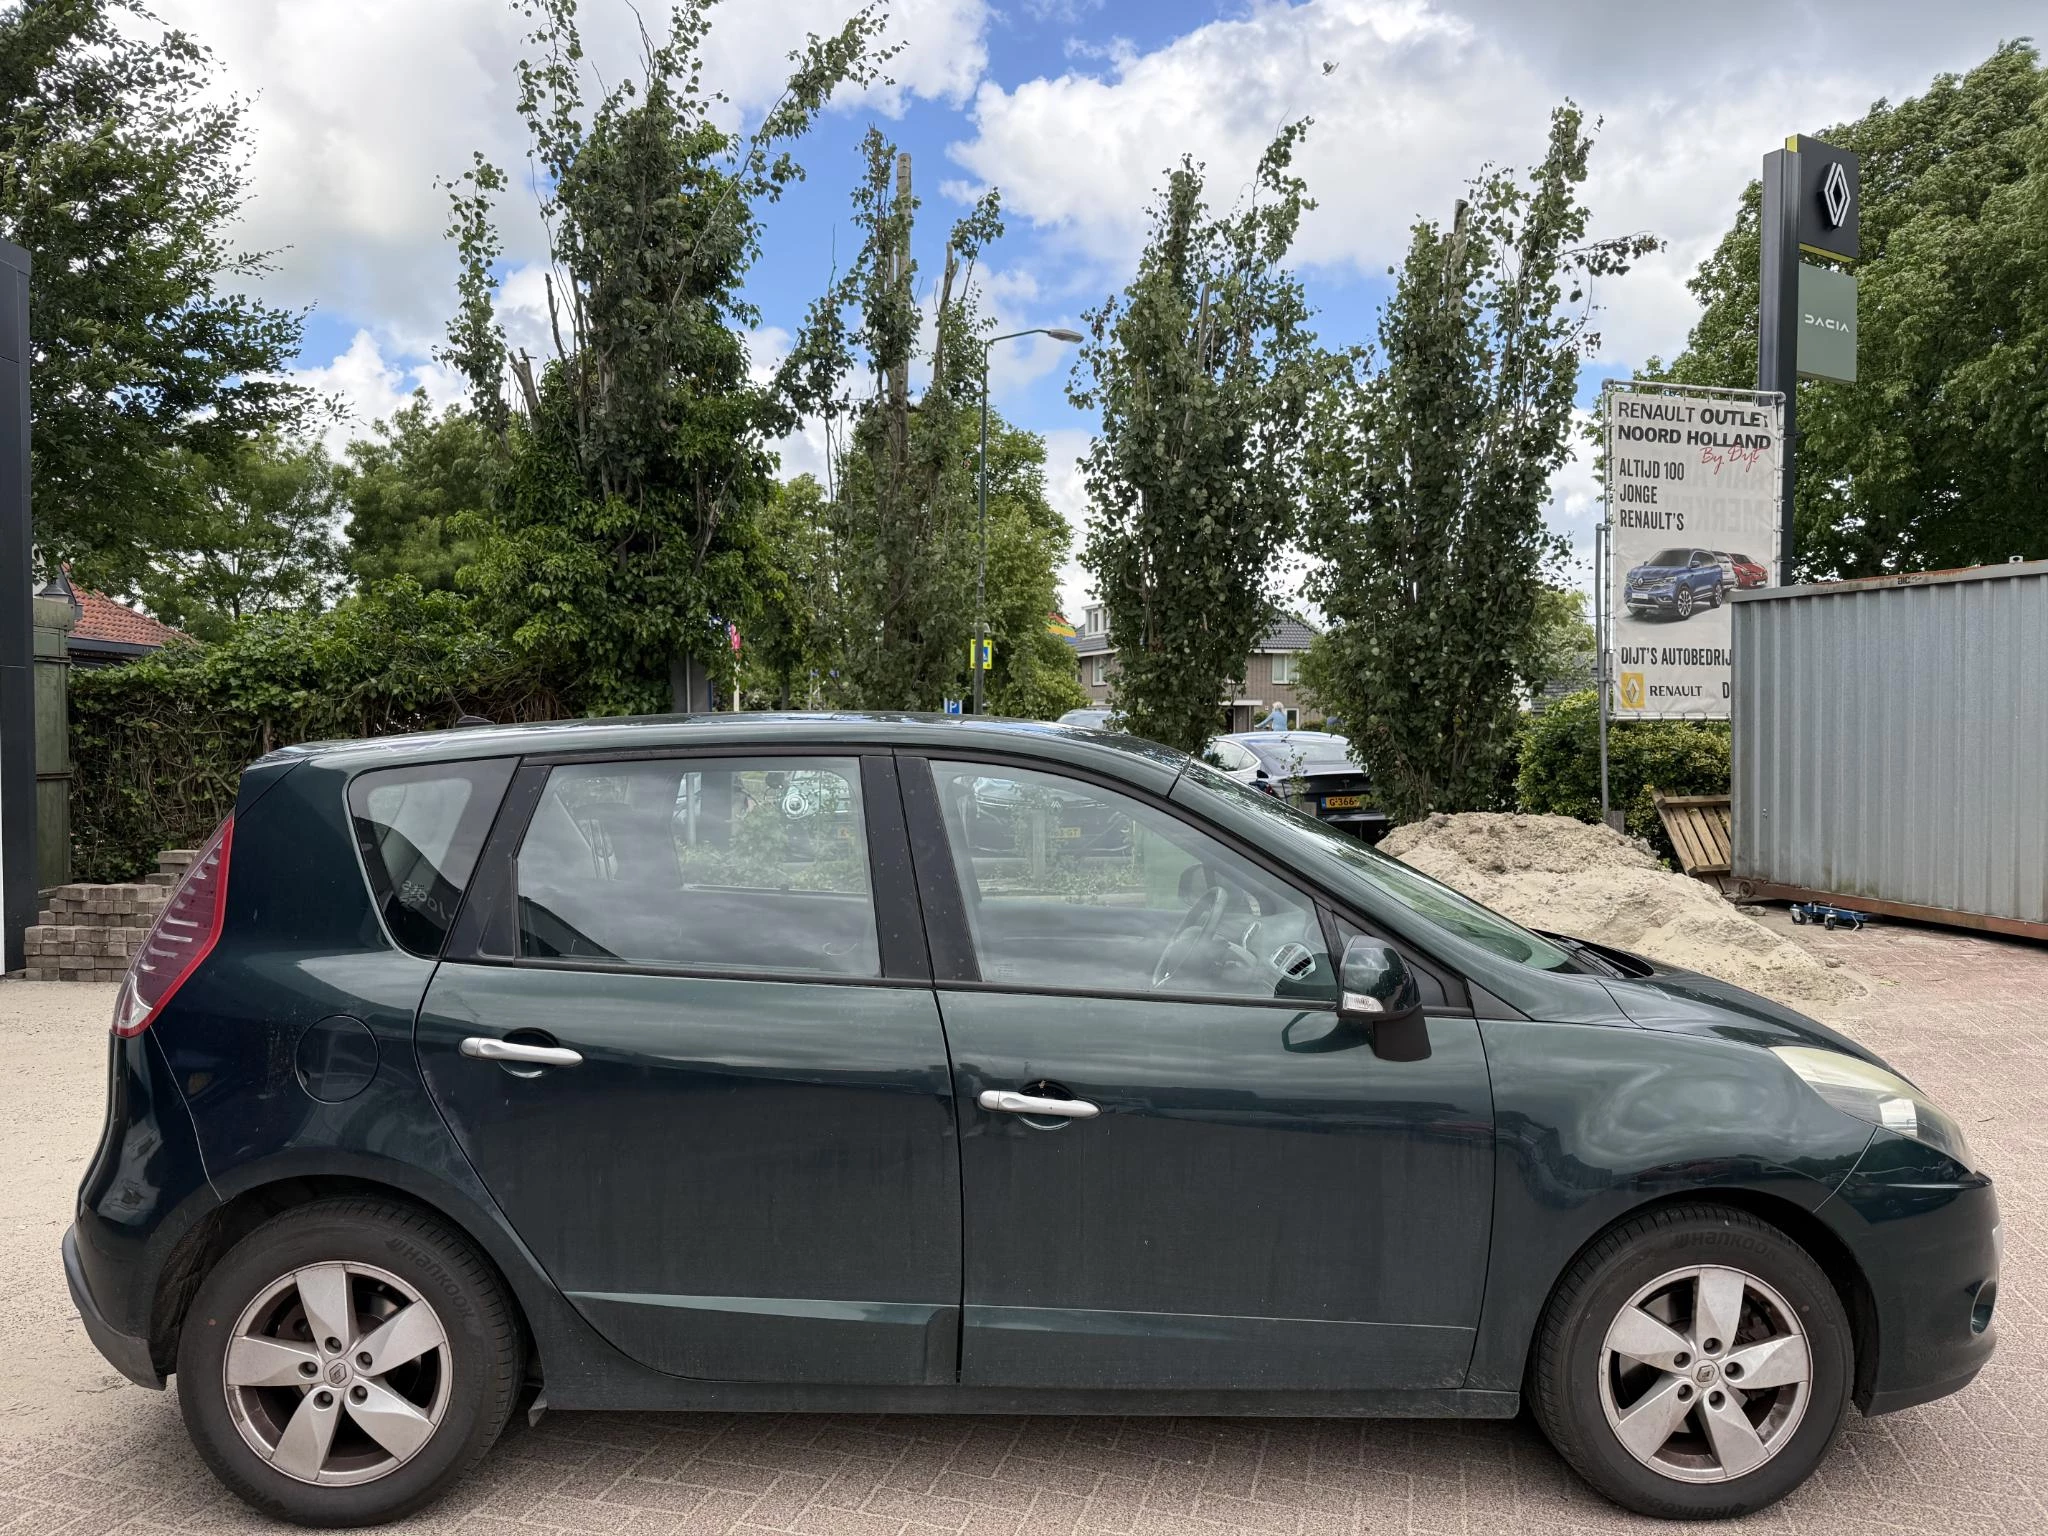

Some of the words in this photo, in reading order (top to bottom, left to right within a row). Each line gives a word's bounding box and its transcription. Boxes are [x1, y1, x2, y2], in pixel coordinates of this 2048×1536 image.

[1804, 313, 1849, 333] DACIA
[1618, 401, 1695, 423] RENAULT
[1618, 424, 1681, 444] NOORD
[1687, 430, 1771, 450] HOLLAND
[1619, 458, 1660, 479] ALTIJD
[1664, 461, 1684, 481] 100
[1700, 446, 1723, 475] By
[1619, 484, 1657, 504] JONGE
[1620, 509, 1684, 531] RENAULT'S
[1620, 646, 1658, 665] DIJT'S
[1660, 647, 1731, 666] AUTOBEDRIJ
[1649, 685, 1703, 697] RENAULT
